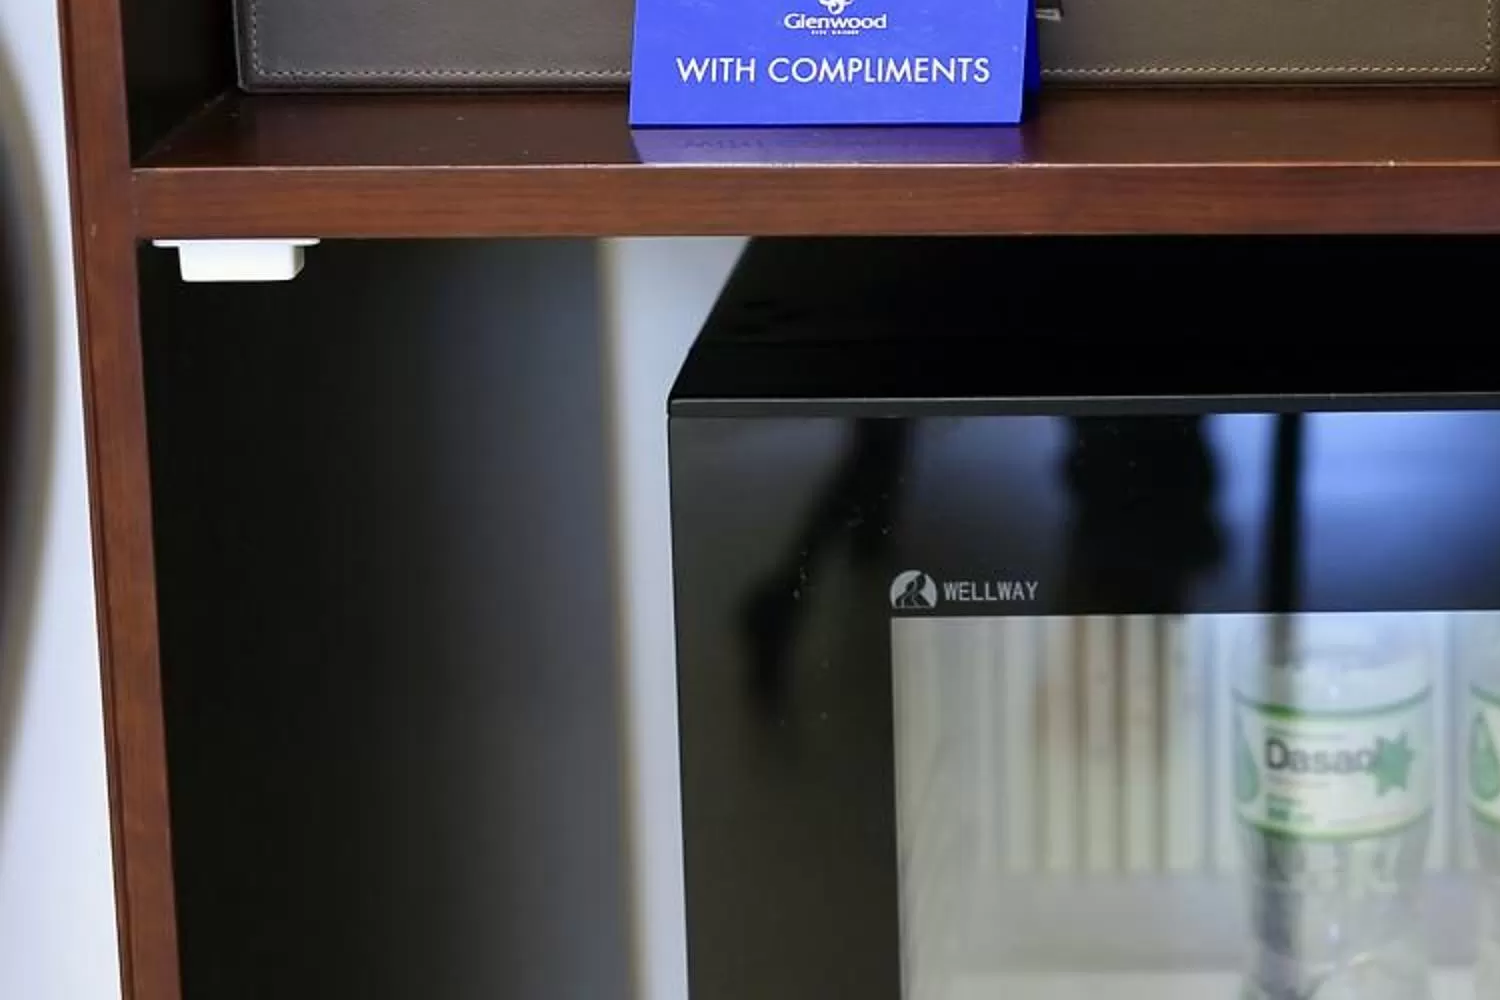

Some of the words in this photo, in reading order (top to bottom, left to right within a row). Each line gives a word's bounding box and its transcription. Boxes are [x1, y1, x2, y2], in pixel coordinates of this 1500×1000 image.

[783, 12, 888, 29] Glenwood
[676, 57, 757, 83] WITH
[767, 57, 991, 84] COMPLIMENTS
[943, 581, 1039, 601] WELLWAY
